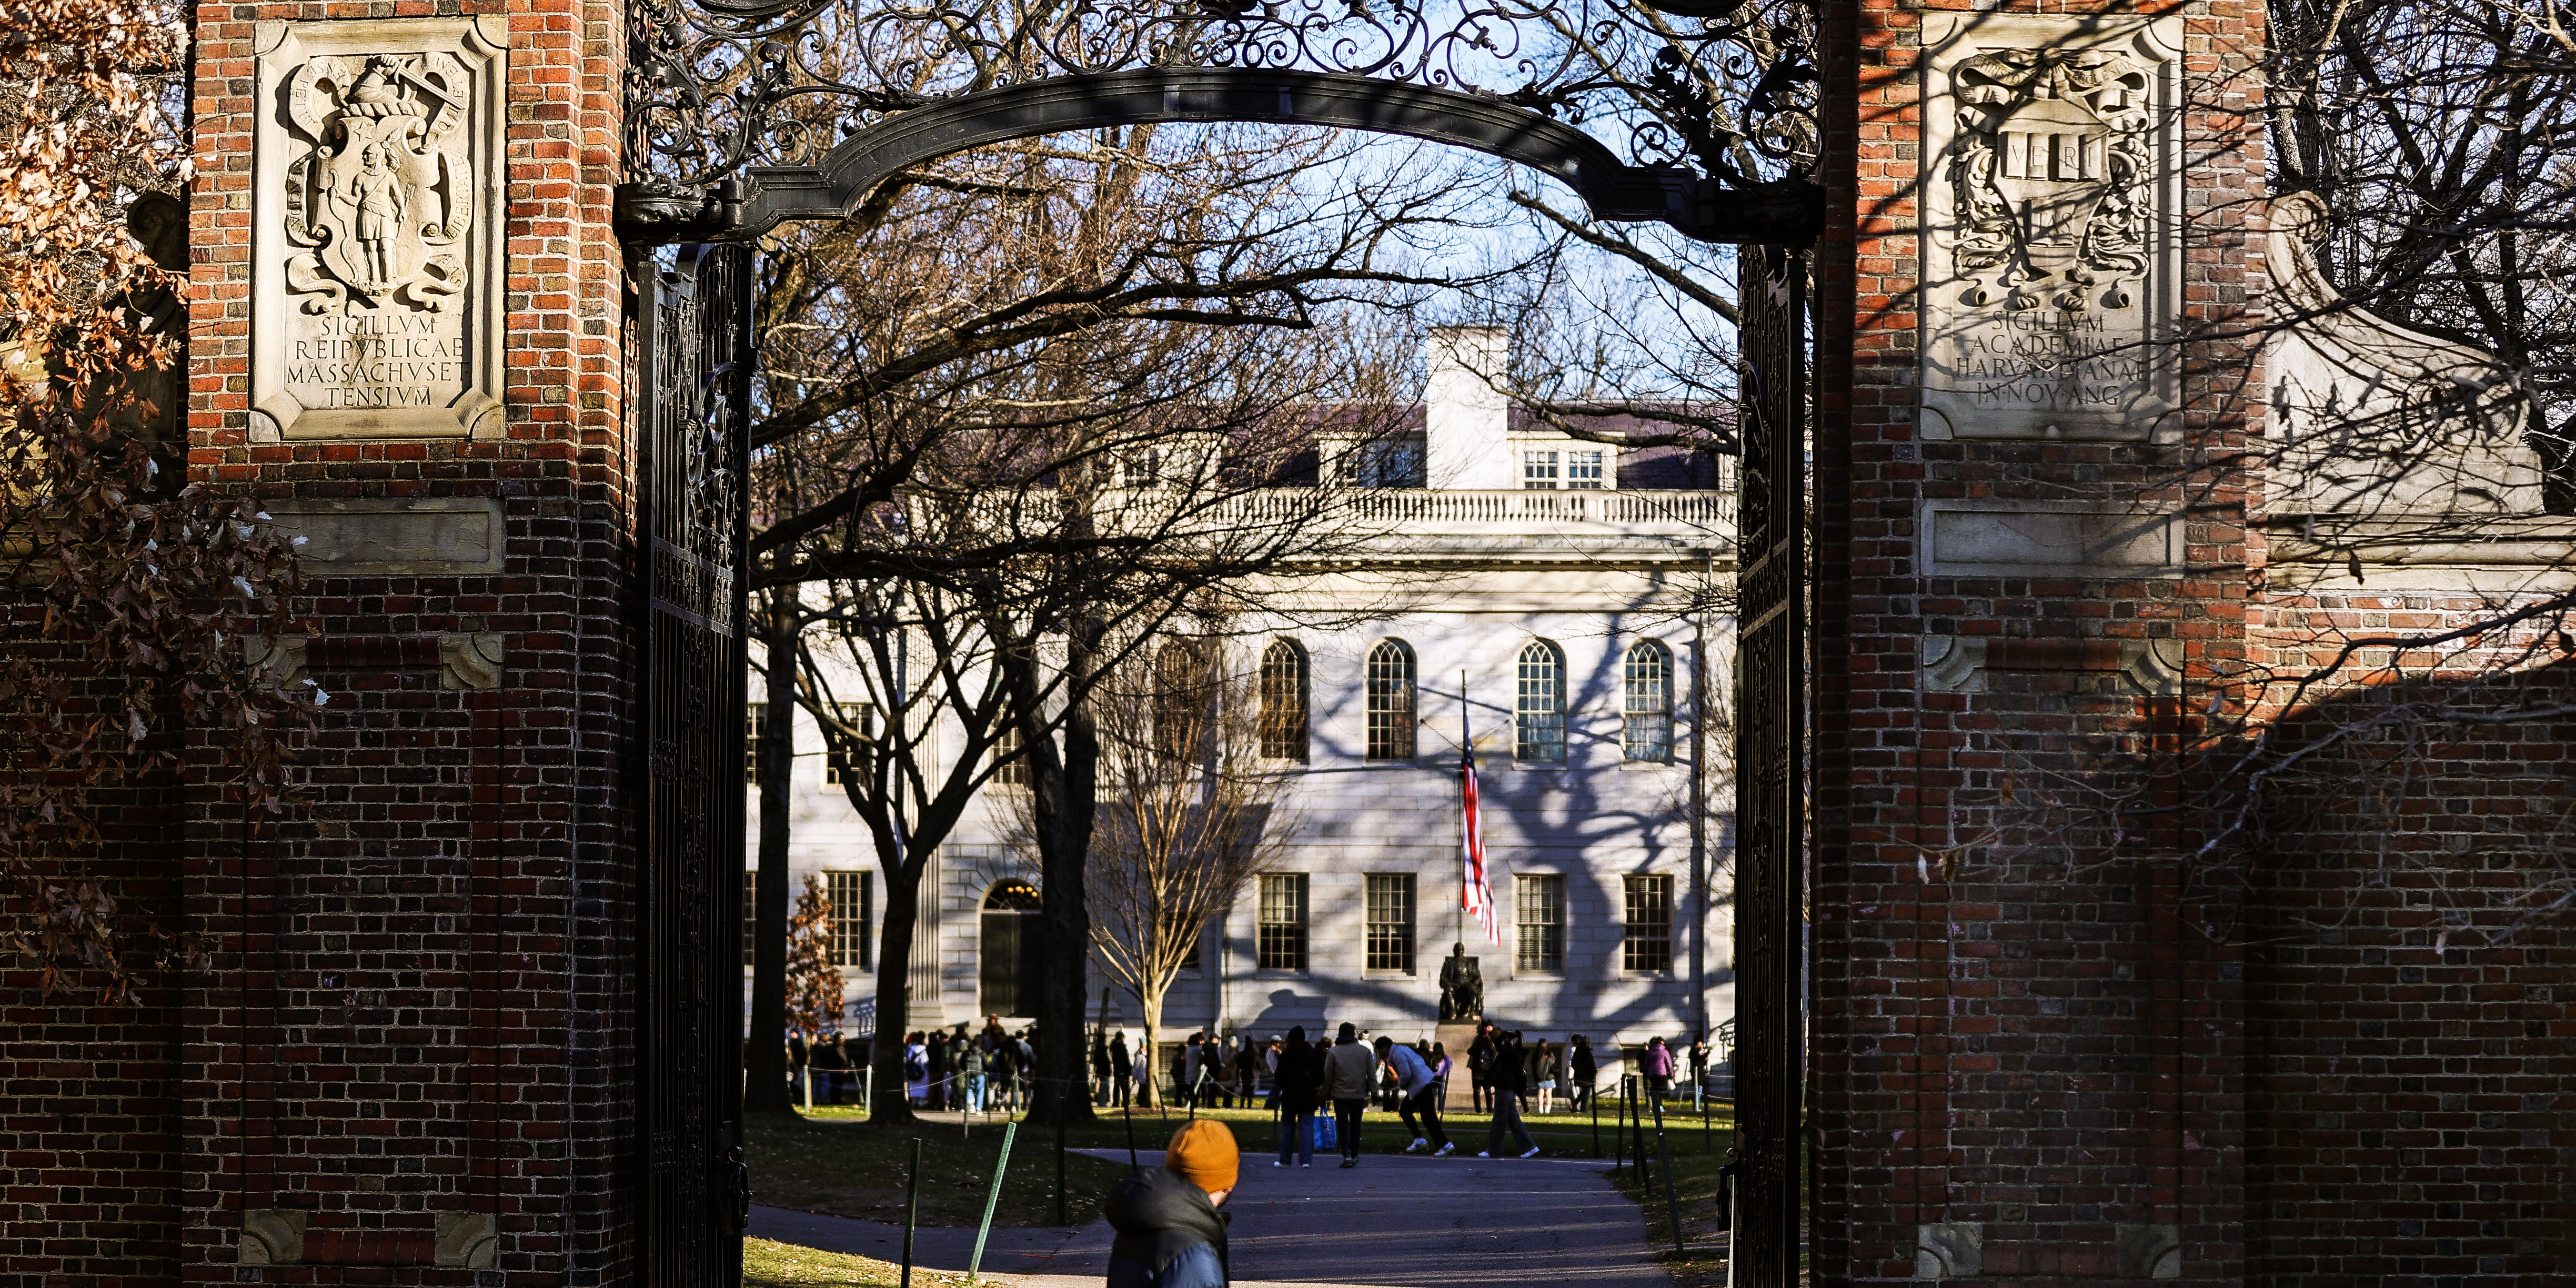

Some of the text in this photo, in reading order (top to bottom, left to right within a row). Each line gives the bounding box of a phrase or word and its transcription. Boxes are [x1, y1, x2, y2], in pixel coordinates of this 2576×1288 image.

[321, 315, 435, 336] SIGILLVM
[1992, 310, 2104, 333] SIGILLVM
[295, 338, 464, 359] REIPVBLICAE
[287, 361, 470, 384] MASSACHVSET
[324, 386, 431, 406] TENSIVM
